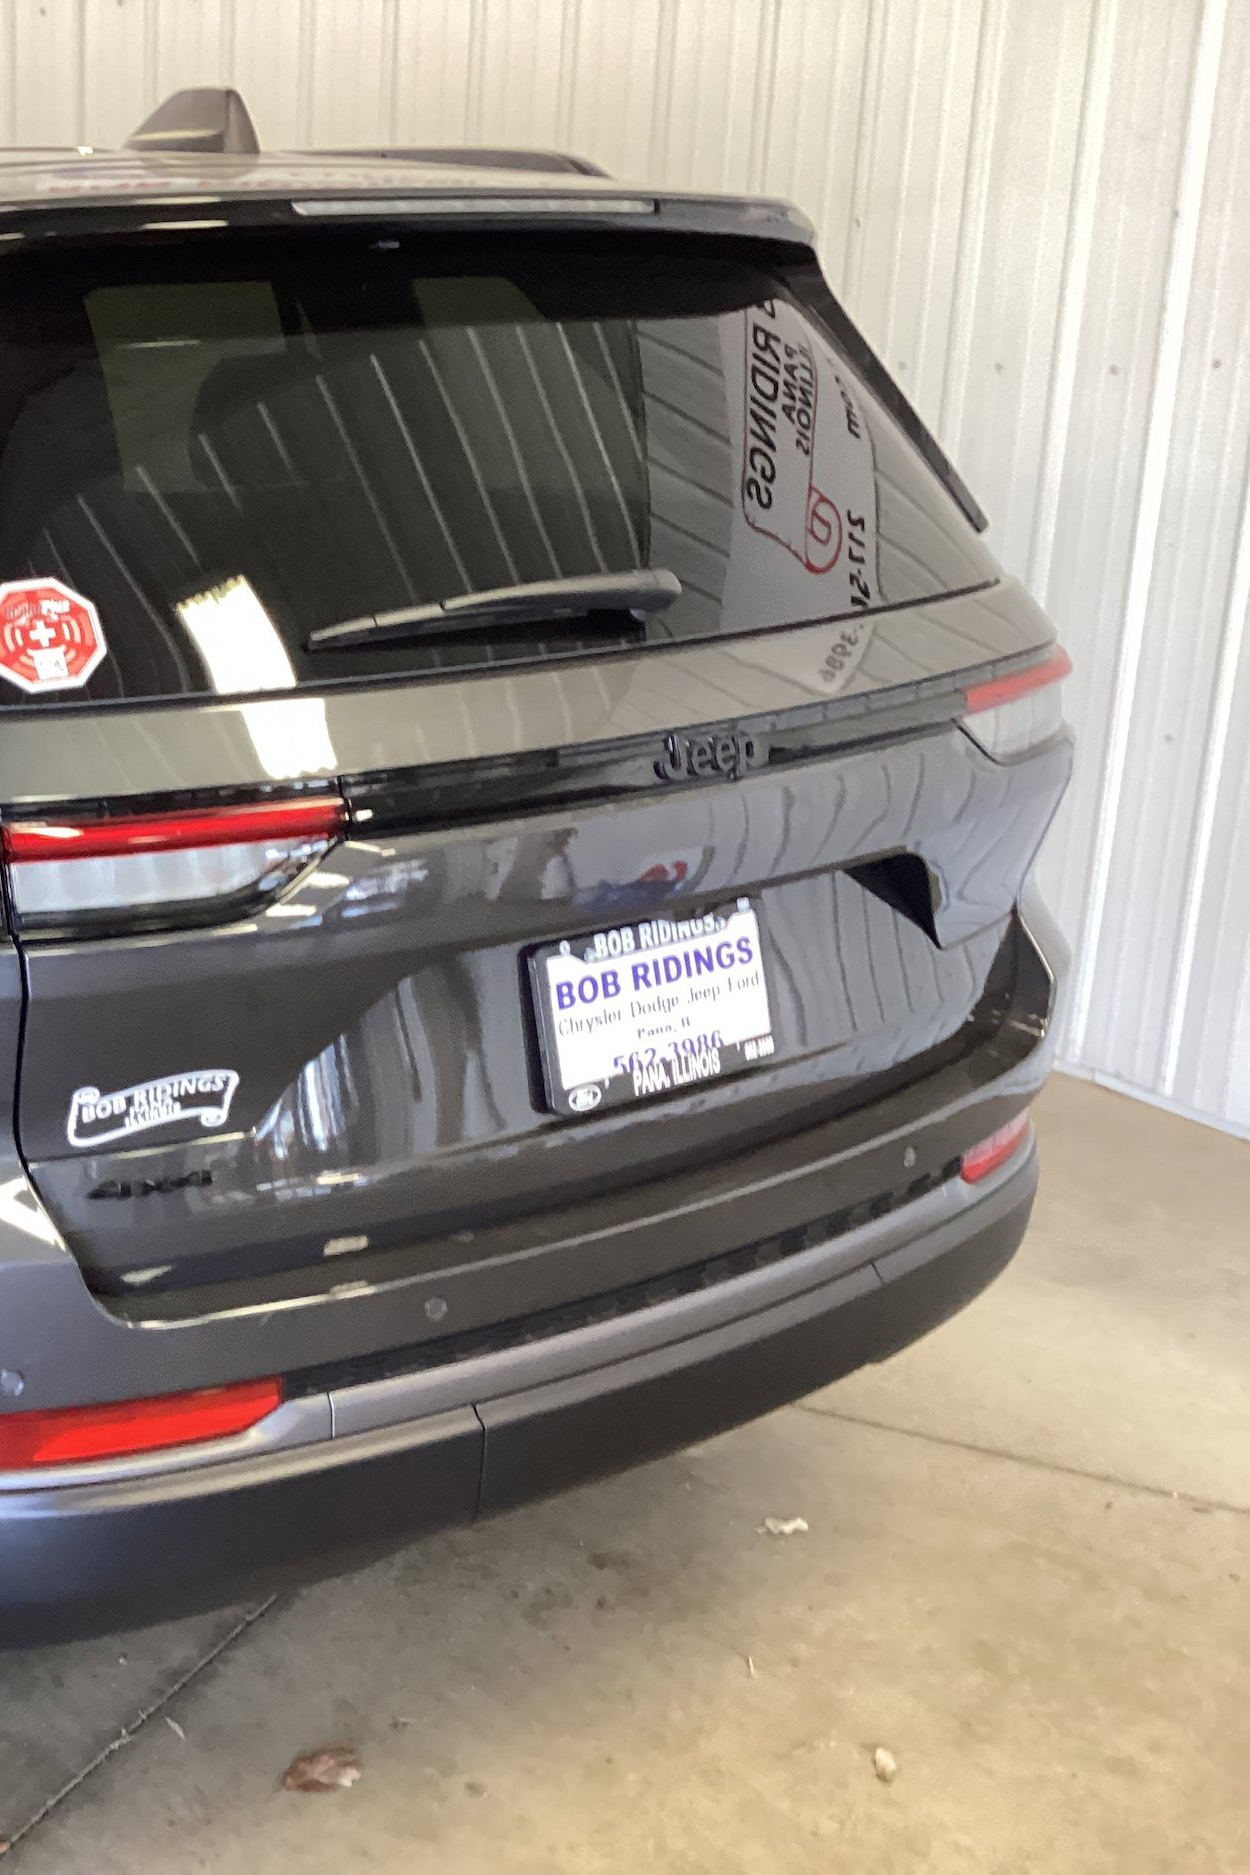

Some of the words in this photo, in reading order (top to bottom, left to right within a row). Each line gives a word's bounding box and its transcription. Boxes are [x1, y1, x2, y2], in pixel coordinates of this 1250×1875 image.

[653, 733, 769, 782] Jeep
[592, 926, 636, 961] BOB
[555, 968, 622, 1011] BOB
[630, 935, 754, 993] RIDINGS
[558, 1007, 622, 1036] Chrysler
[630, 994, 680, 1018] Dodge
[671, 1047, 722, 1086] ILLINOIS
